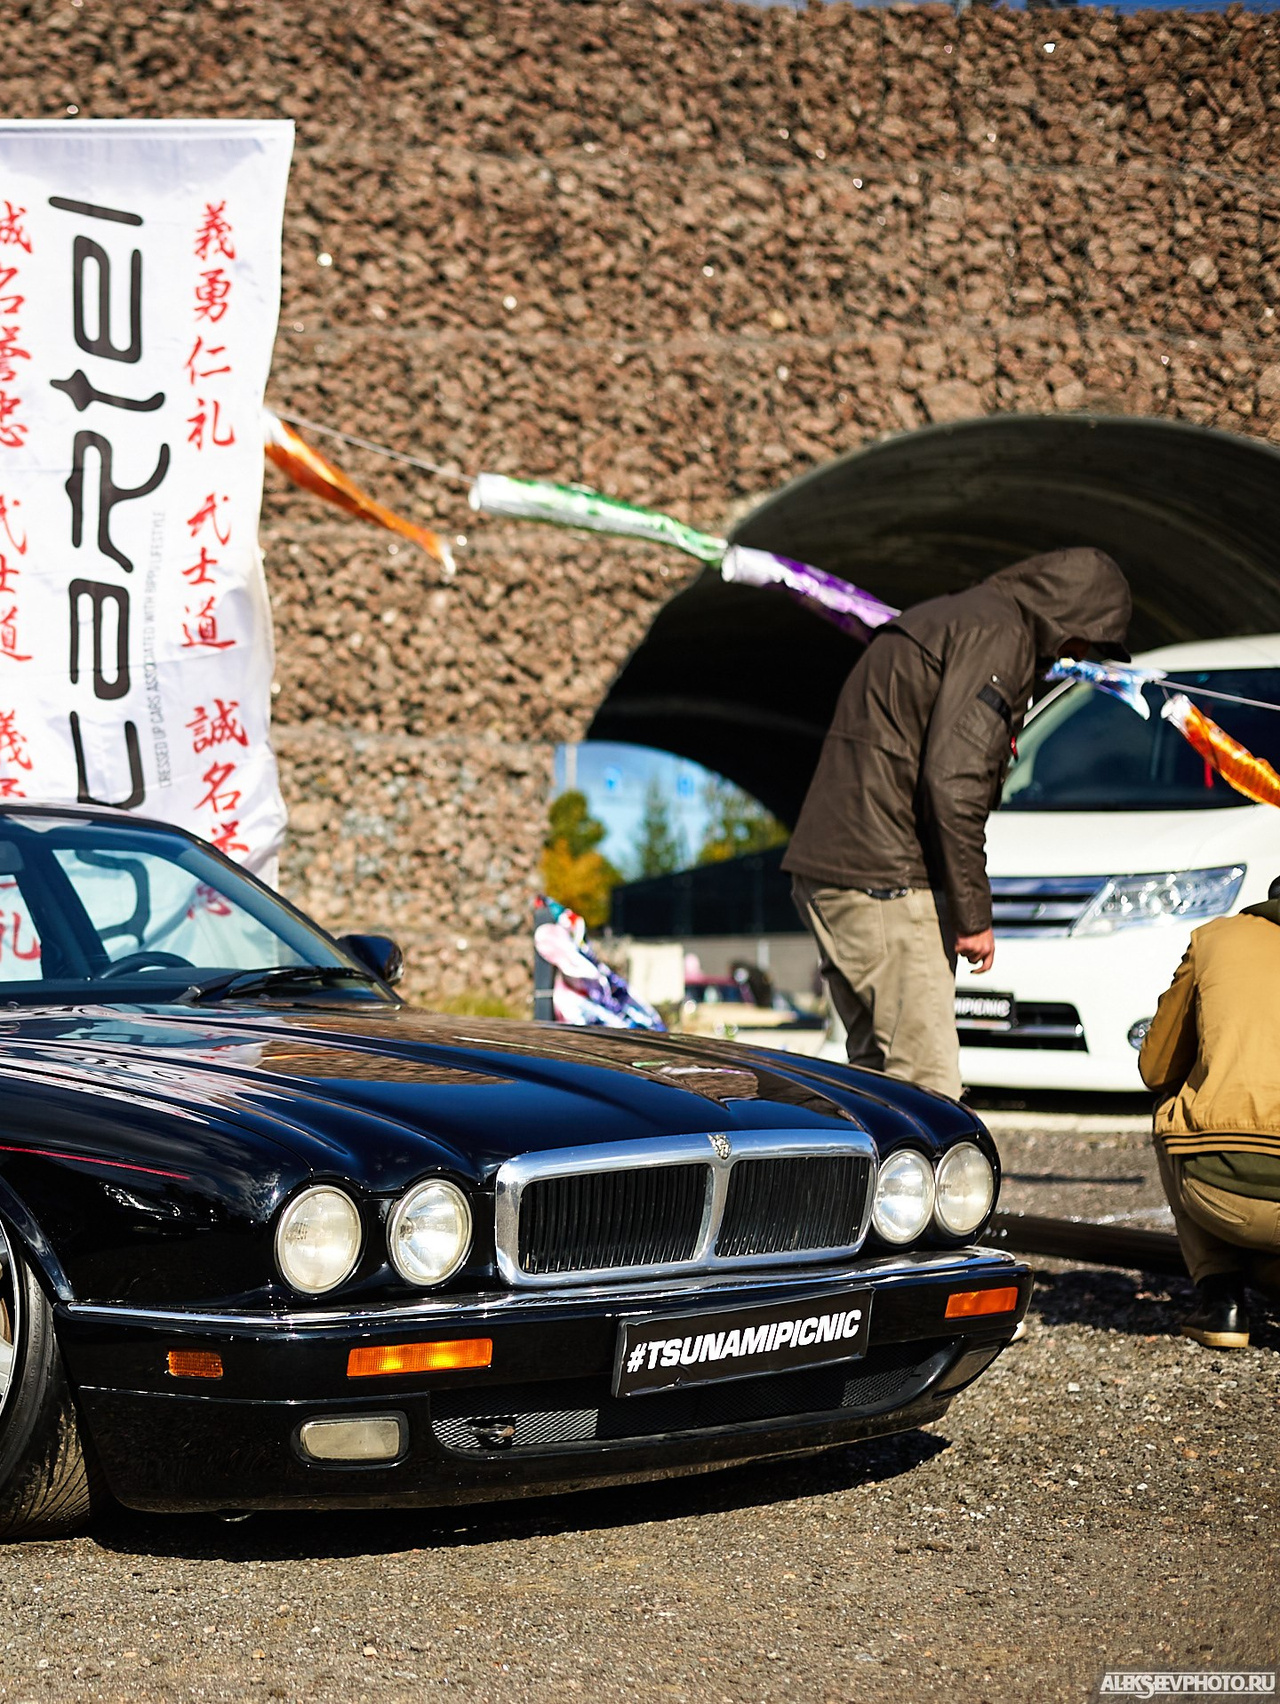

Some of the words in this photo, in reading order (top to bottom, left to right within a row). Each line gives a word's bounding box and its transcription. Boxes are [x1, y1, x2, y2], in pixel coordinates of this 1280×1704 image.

[143, 625, 159, 692] ASSOCIATED
[147, 694, 164, 724] CARS
[152, 726, 167, 740] UP
[154, 741, 172, 789] DRESSED
[626, 1309, 862, 1374] #TSUNAMIPICNIC
